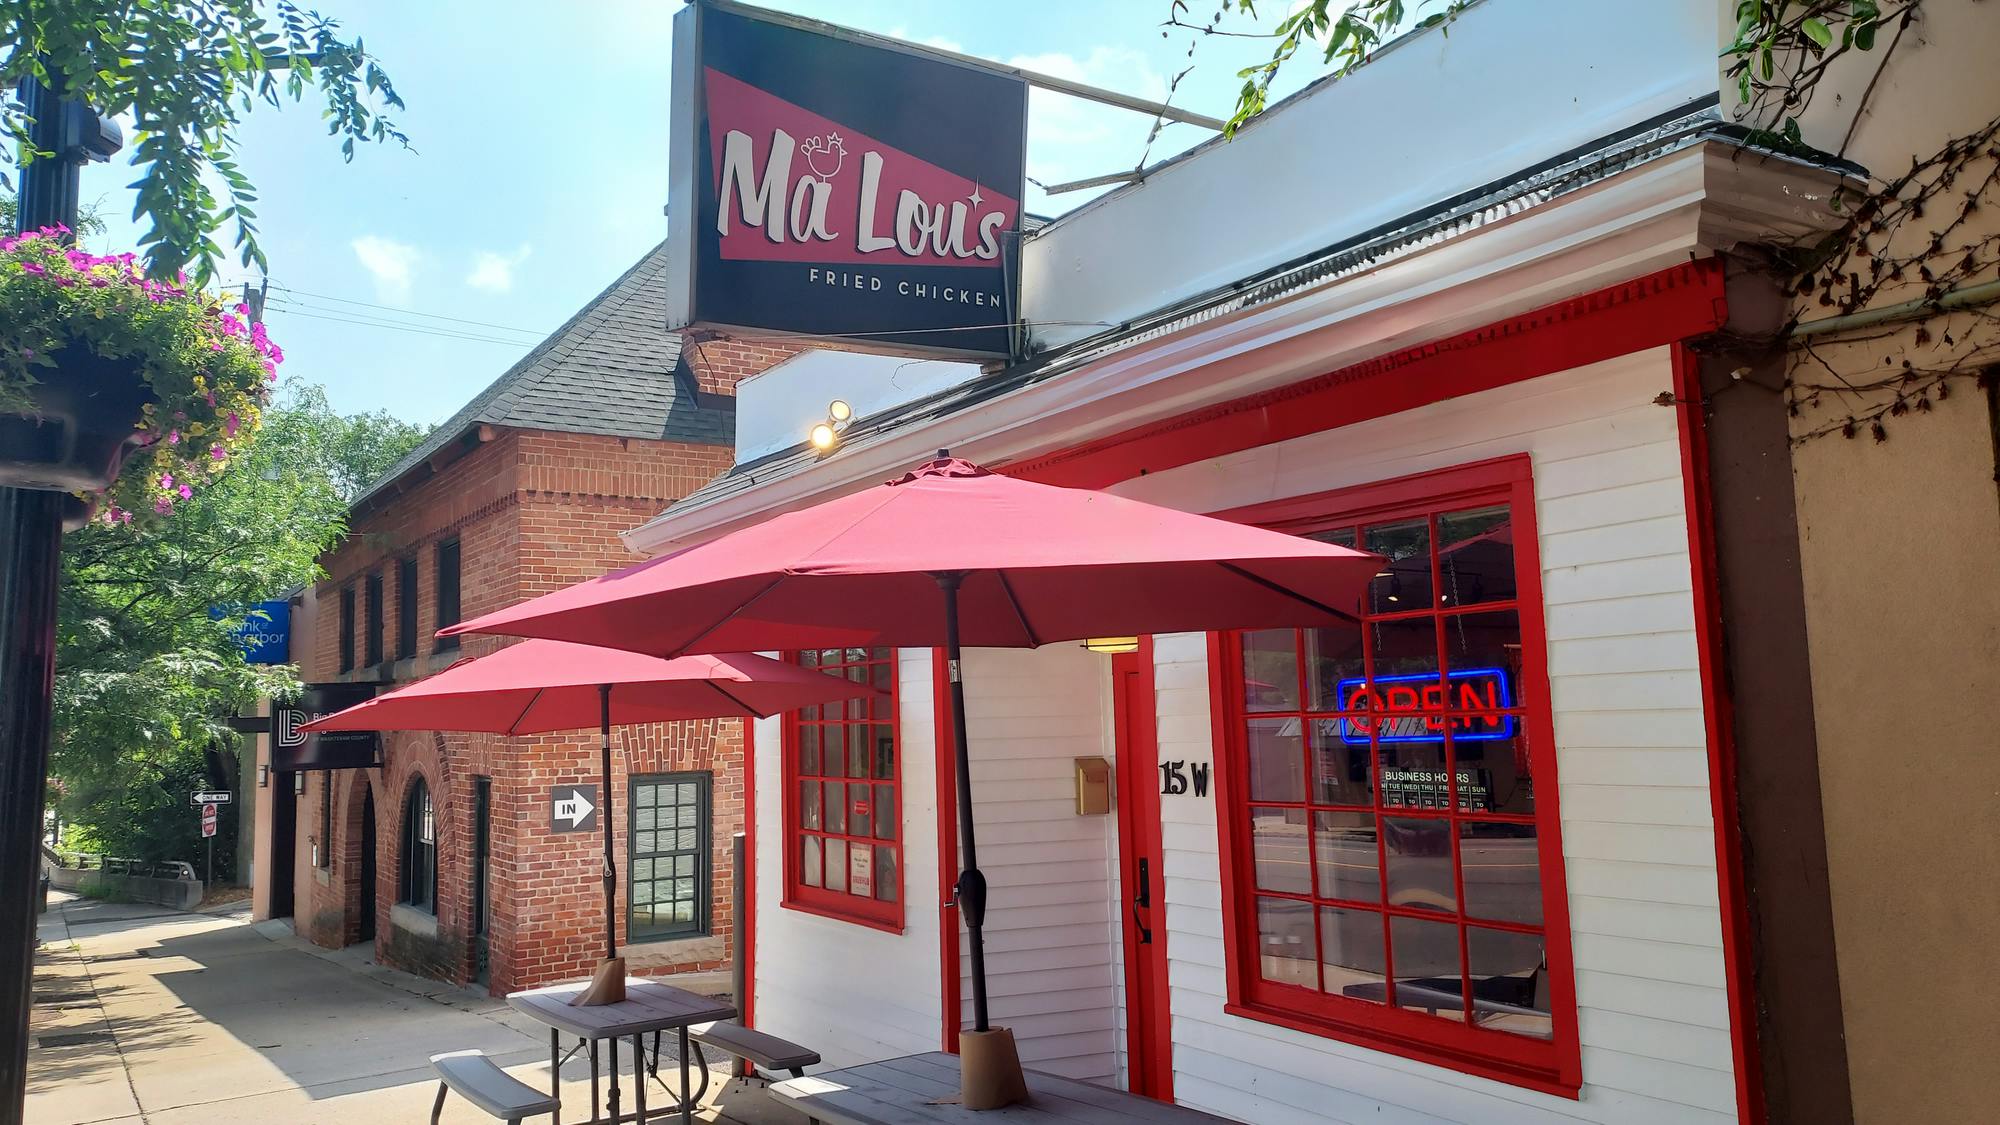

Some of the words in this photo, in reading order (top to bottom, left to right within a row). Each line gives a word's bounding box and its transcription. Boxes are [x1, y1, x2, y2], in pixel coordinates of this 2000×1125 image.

[718, 128, 839, 243] Ma
[857, 150, 1006, 260] Lou's
[809, 268, 883, 292] FRIED
[897, 280, 1002, 308] CHICKEN
[1348, 681, 1499, 733] OPEN
[1159, 759, 1187, 795] 15
[1191, 762, 1208, 797] W
[1385, 771, 1432, 782] BUSINESS
[1434, 772, 1469, 783] HORS
[562, 804, 576, 815] IN
